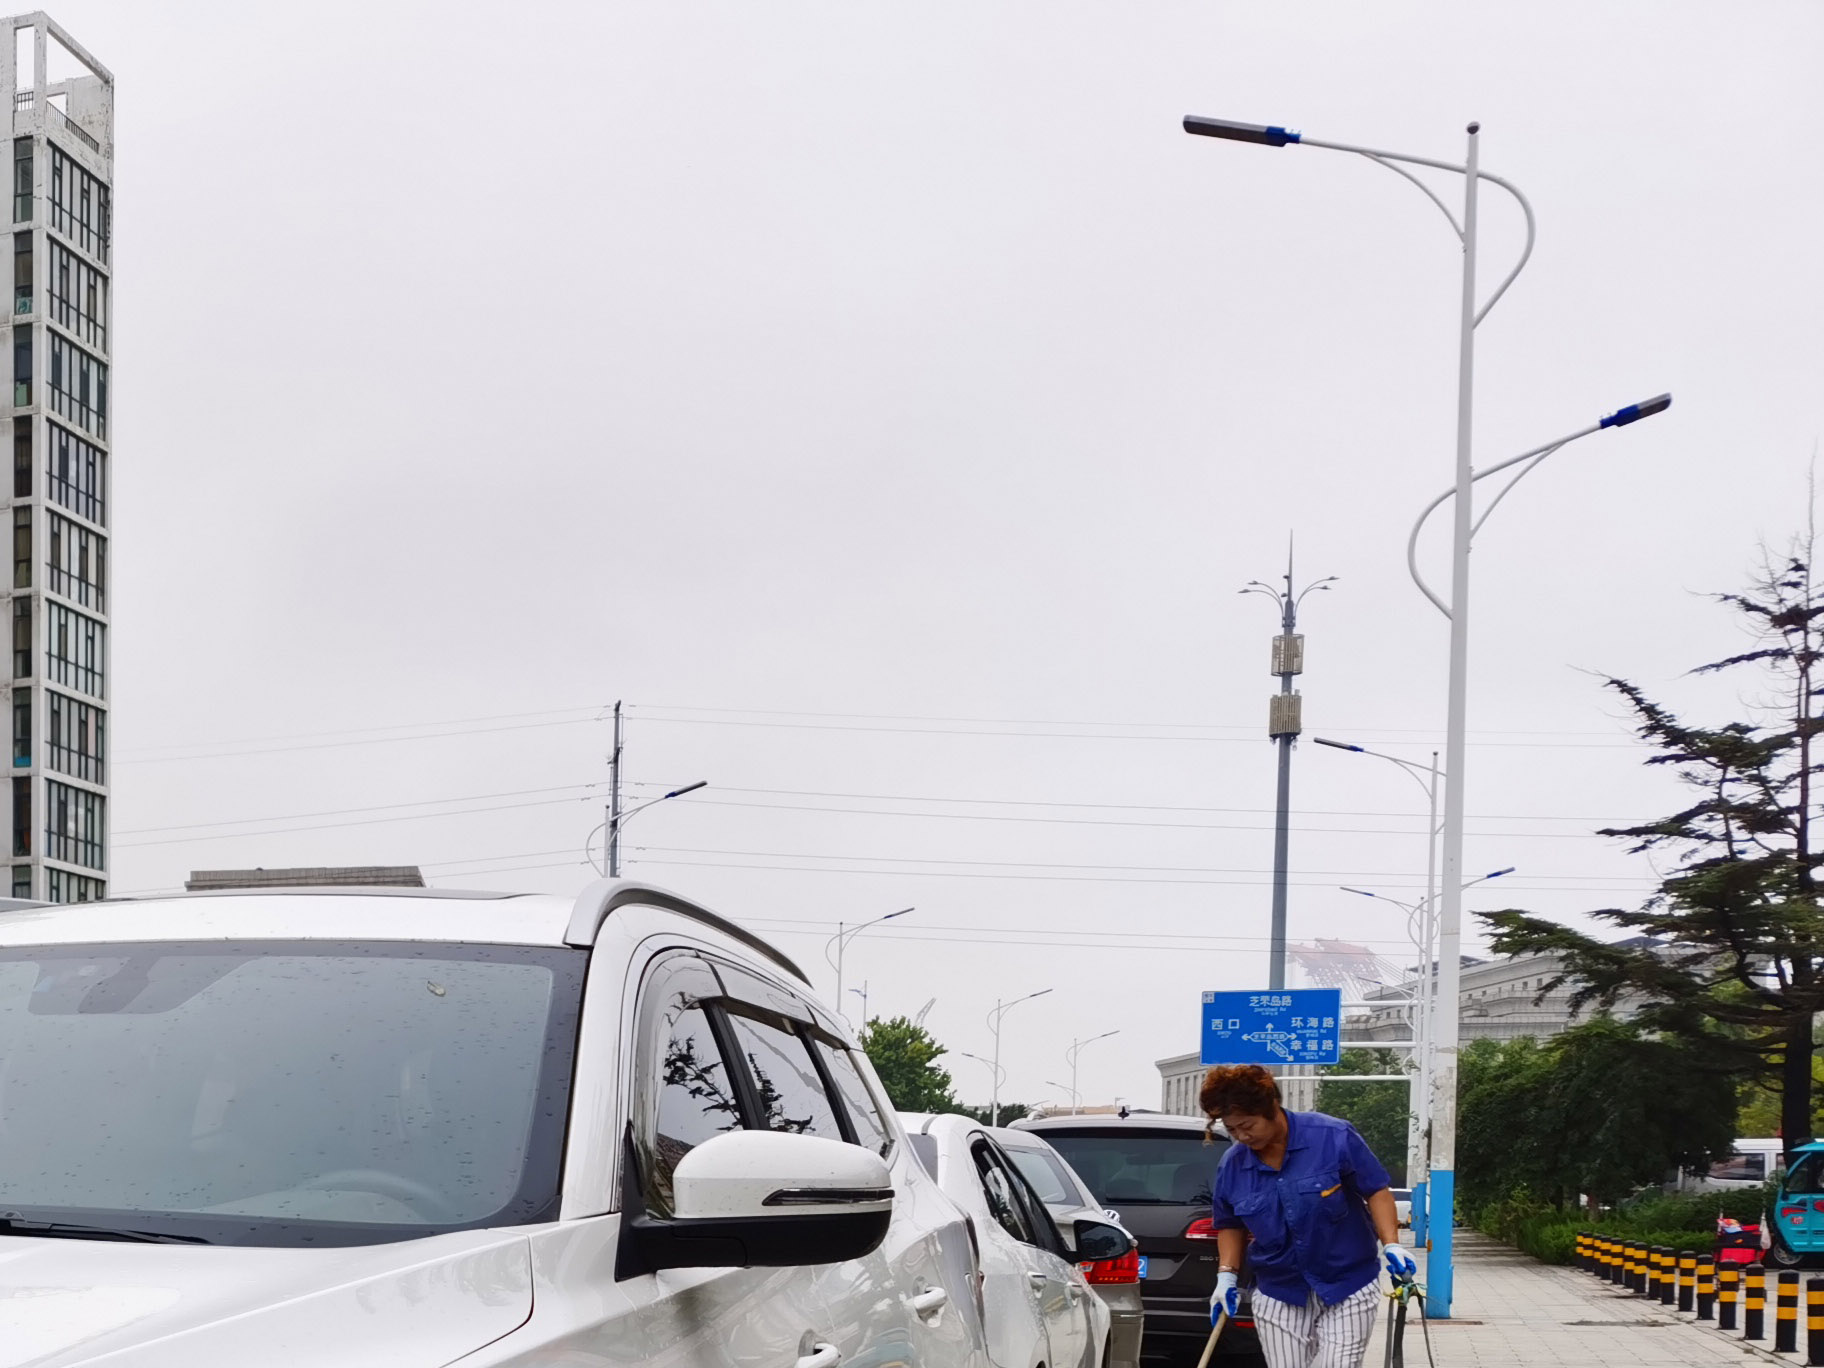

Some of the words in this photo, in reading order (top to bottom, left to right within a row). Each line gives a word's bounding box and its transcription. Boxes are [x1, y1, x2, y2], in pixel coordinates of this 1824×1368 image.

[1211, 1018, 1240, 1030] 西口
[1290, 1016, 1334, 1028] 环海路
[1290, 1039, 1334, 1051] 幸福路
